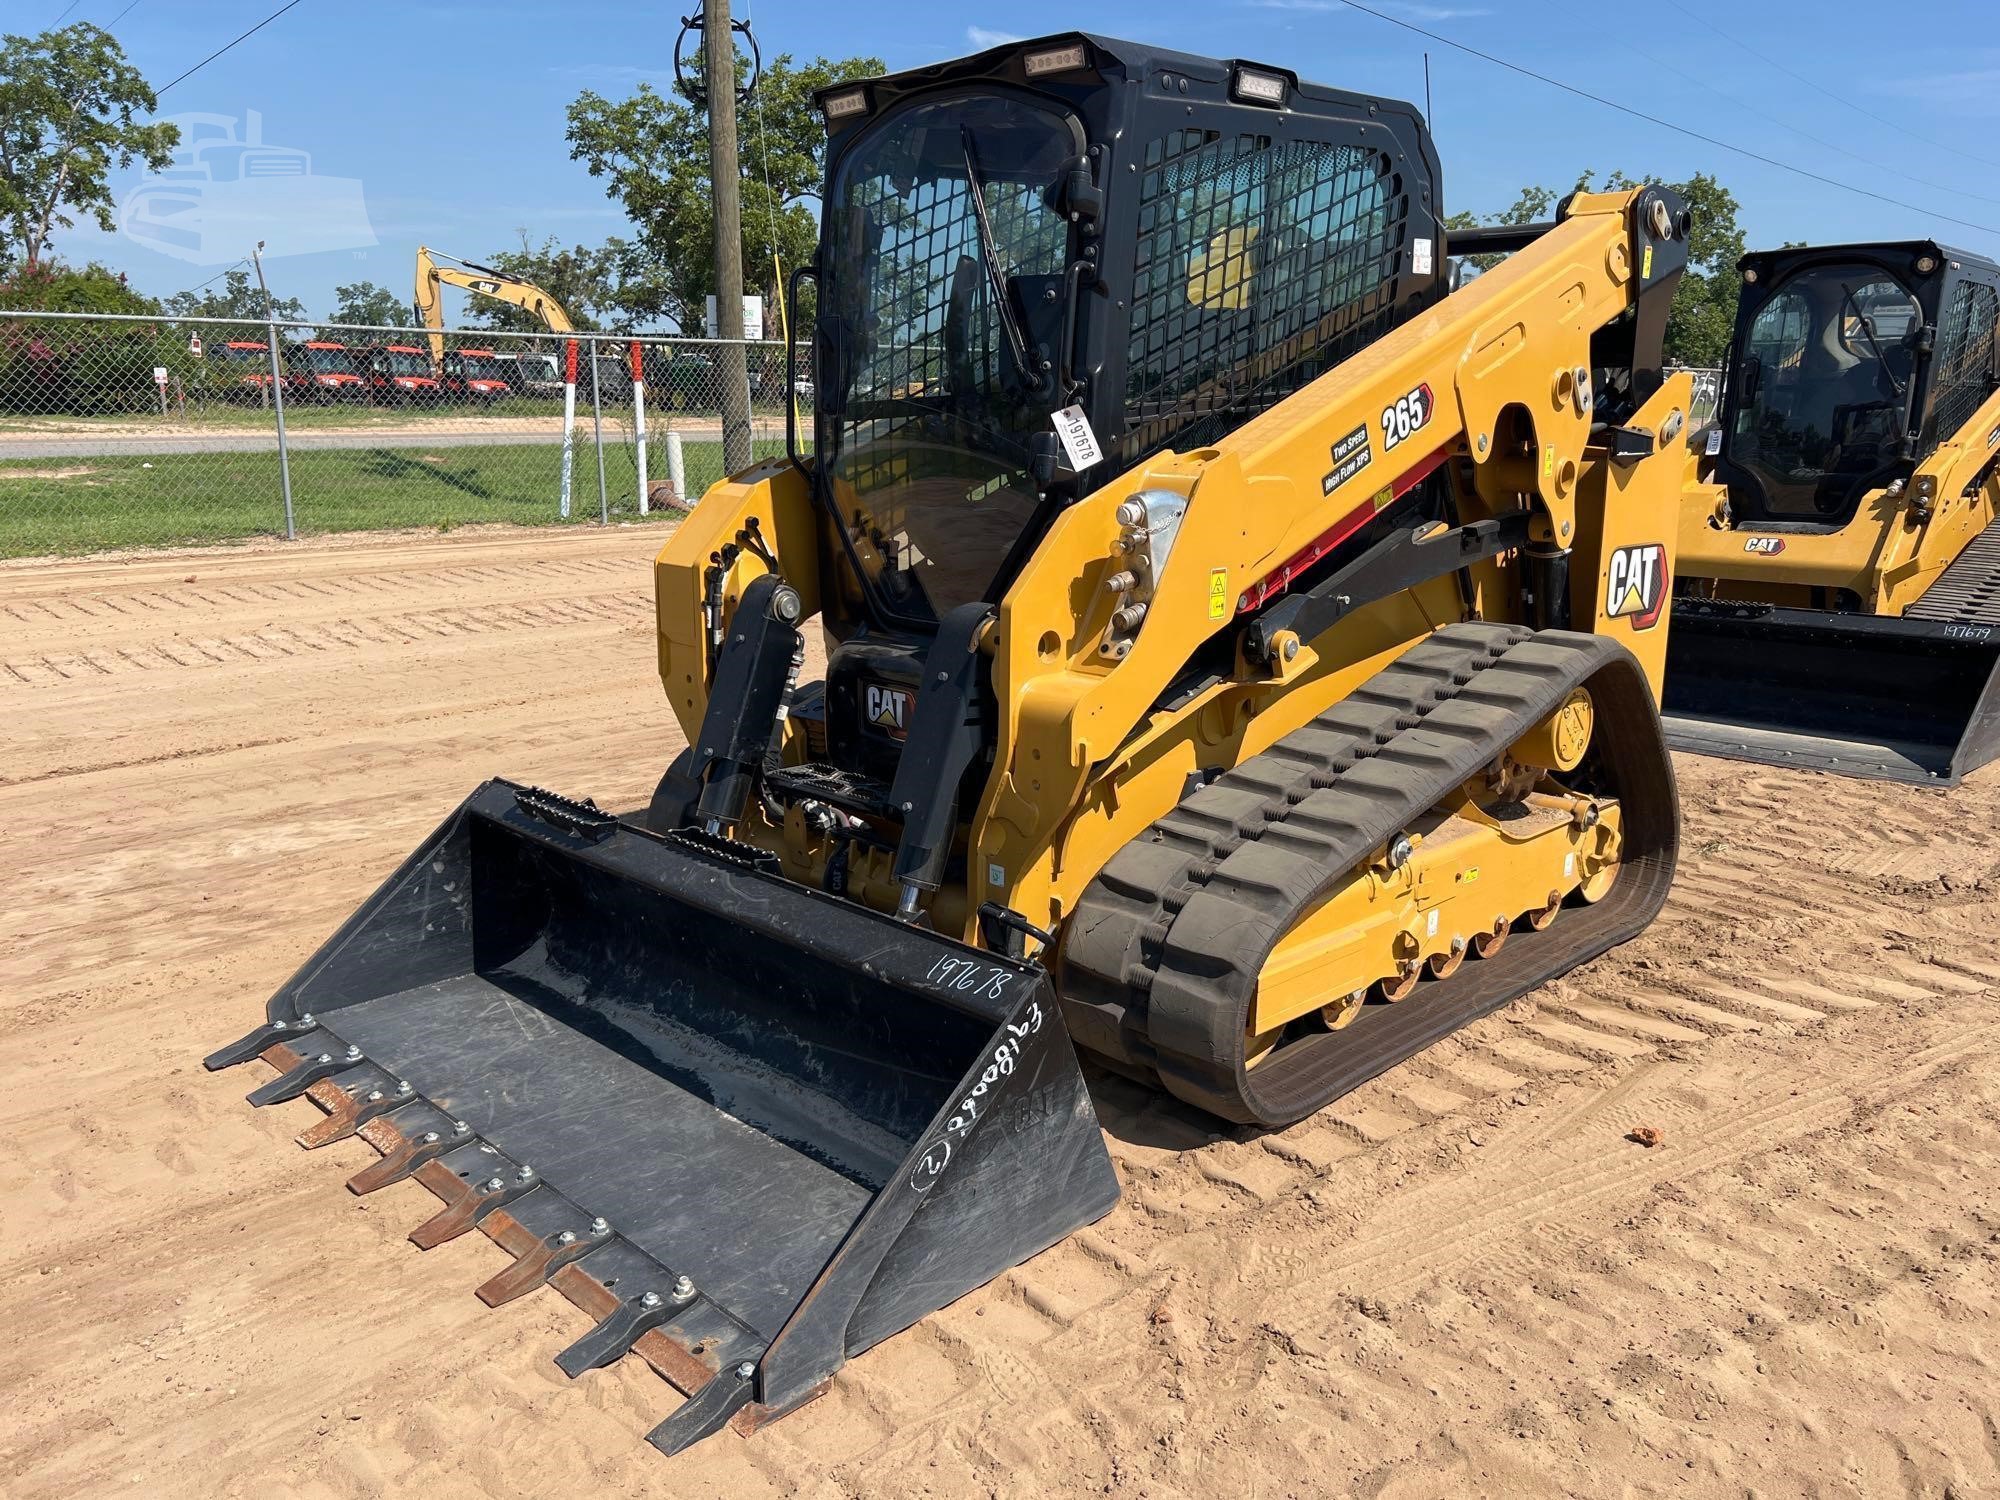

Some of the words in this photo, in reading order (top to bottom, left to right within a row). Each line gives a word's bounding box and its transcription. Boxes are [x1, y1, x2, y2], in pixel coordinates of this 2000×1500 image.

[479, 281, 495, 294] CAT
[1067, 418, 1095, 460] 197678
[1382, 387, 1424, 451] 265
[1356, 449, 1369, 468] XPS
[1744, 537, 1779, 553] CAT
[1607, 546, 1658, 617] CAT
[1943, 625, 1991, 639] 197679
[867, 686, 906, 728] CAT
[926, 953, 1013, 999] 197678
[1013, 1083, 1056, 1134] CAT
